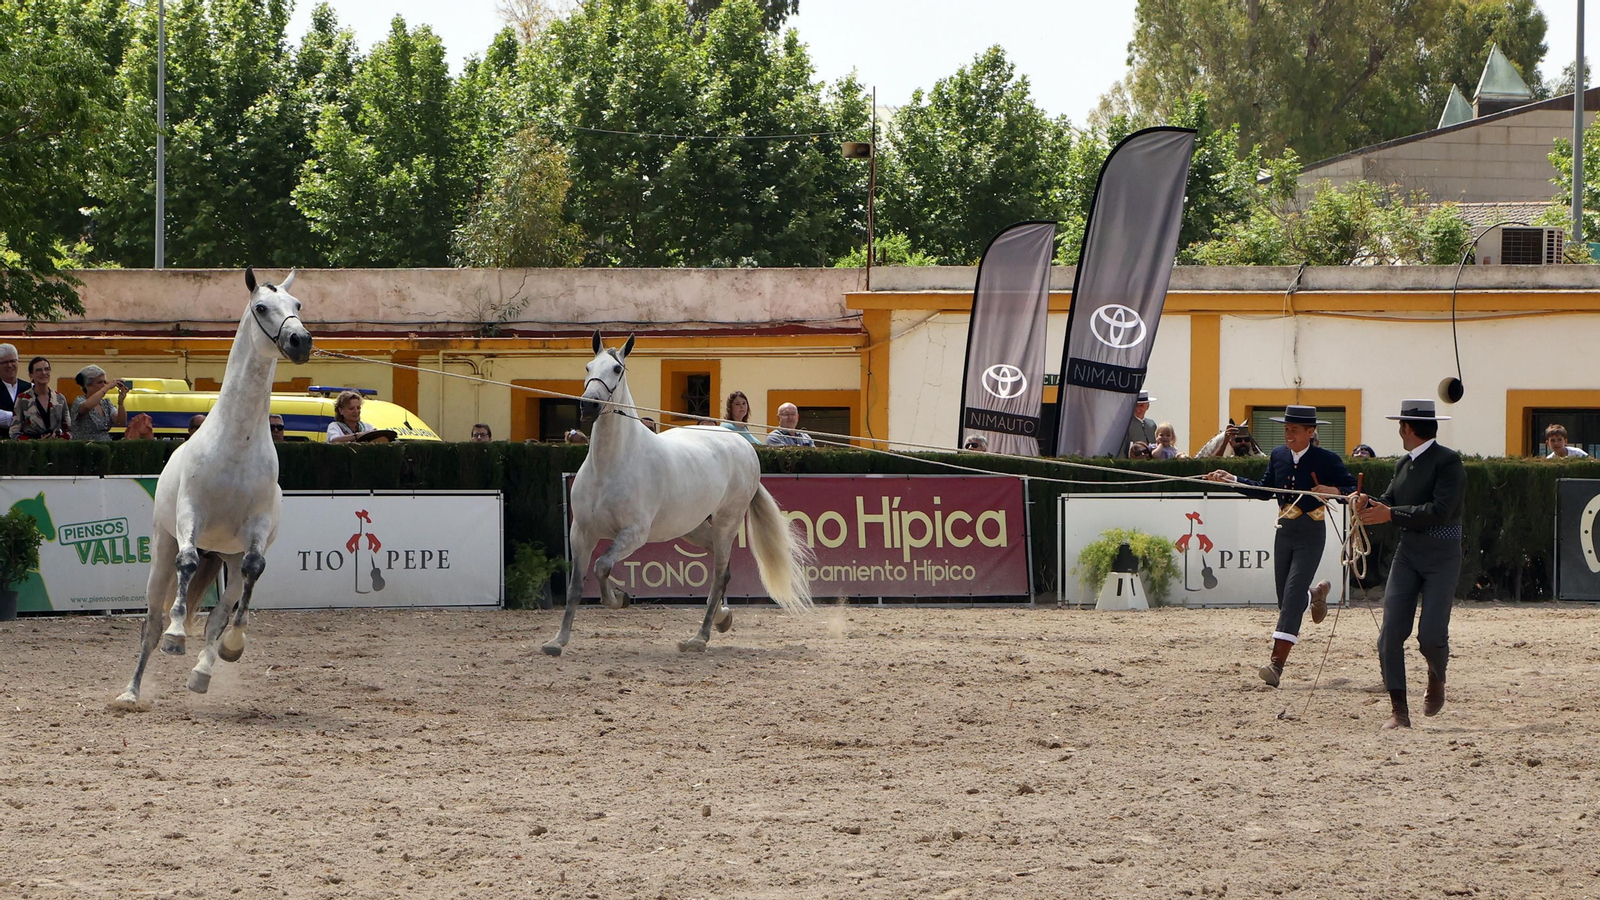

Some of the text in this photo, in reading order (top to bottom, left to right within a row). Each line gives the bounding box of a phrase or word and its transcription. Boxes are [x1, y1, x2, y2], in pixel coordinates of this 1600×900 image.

[969, 411, 1035, 434] NIMAUTO
[64, 521, 124, 540] PIENSOS
[855, 495, 1008, 563] Hípica
[74, 536, 151, 565] VALLE
[298, 549, 450, 571] TIO PEPE
[1218, 550, 1271, 569] PEP
[623, 560, 709, 588] TONO
[913, 559, 976, 587] Hípico
